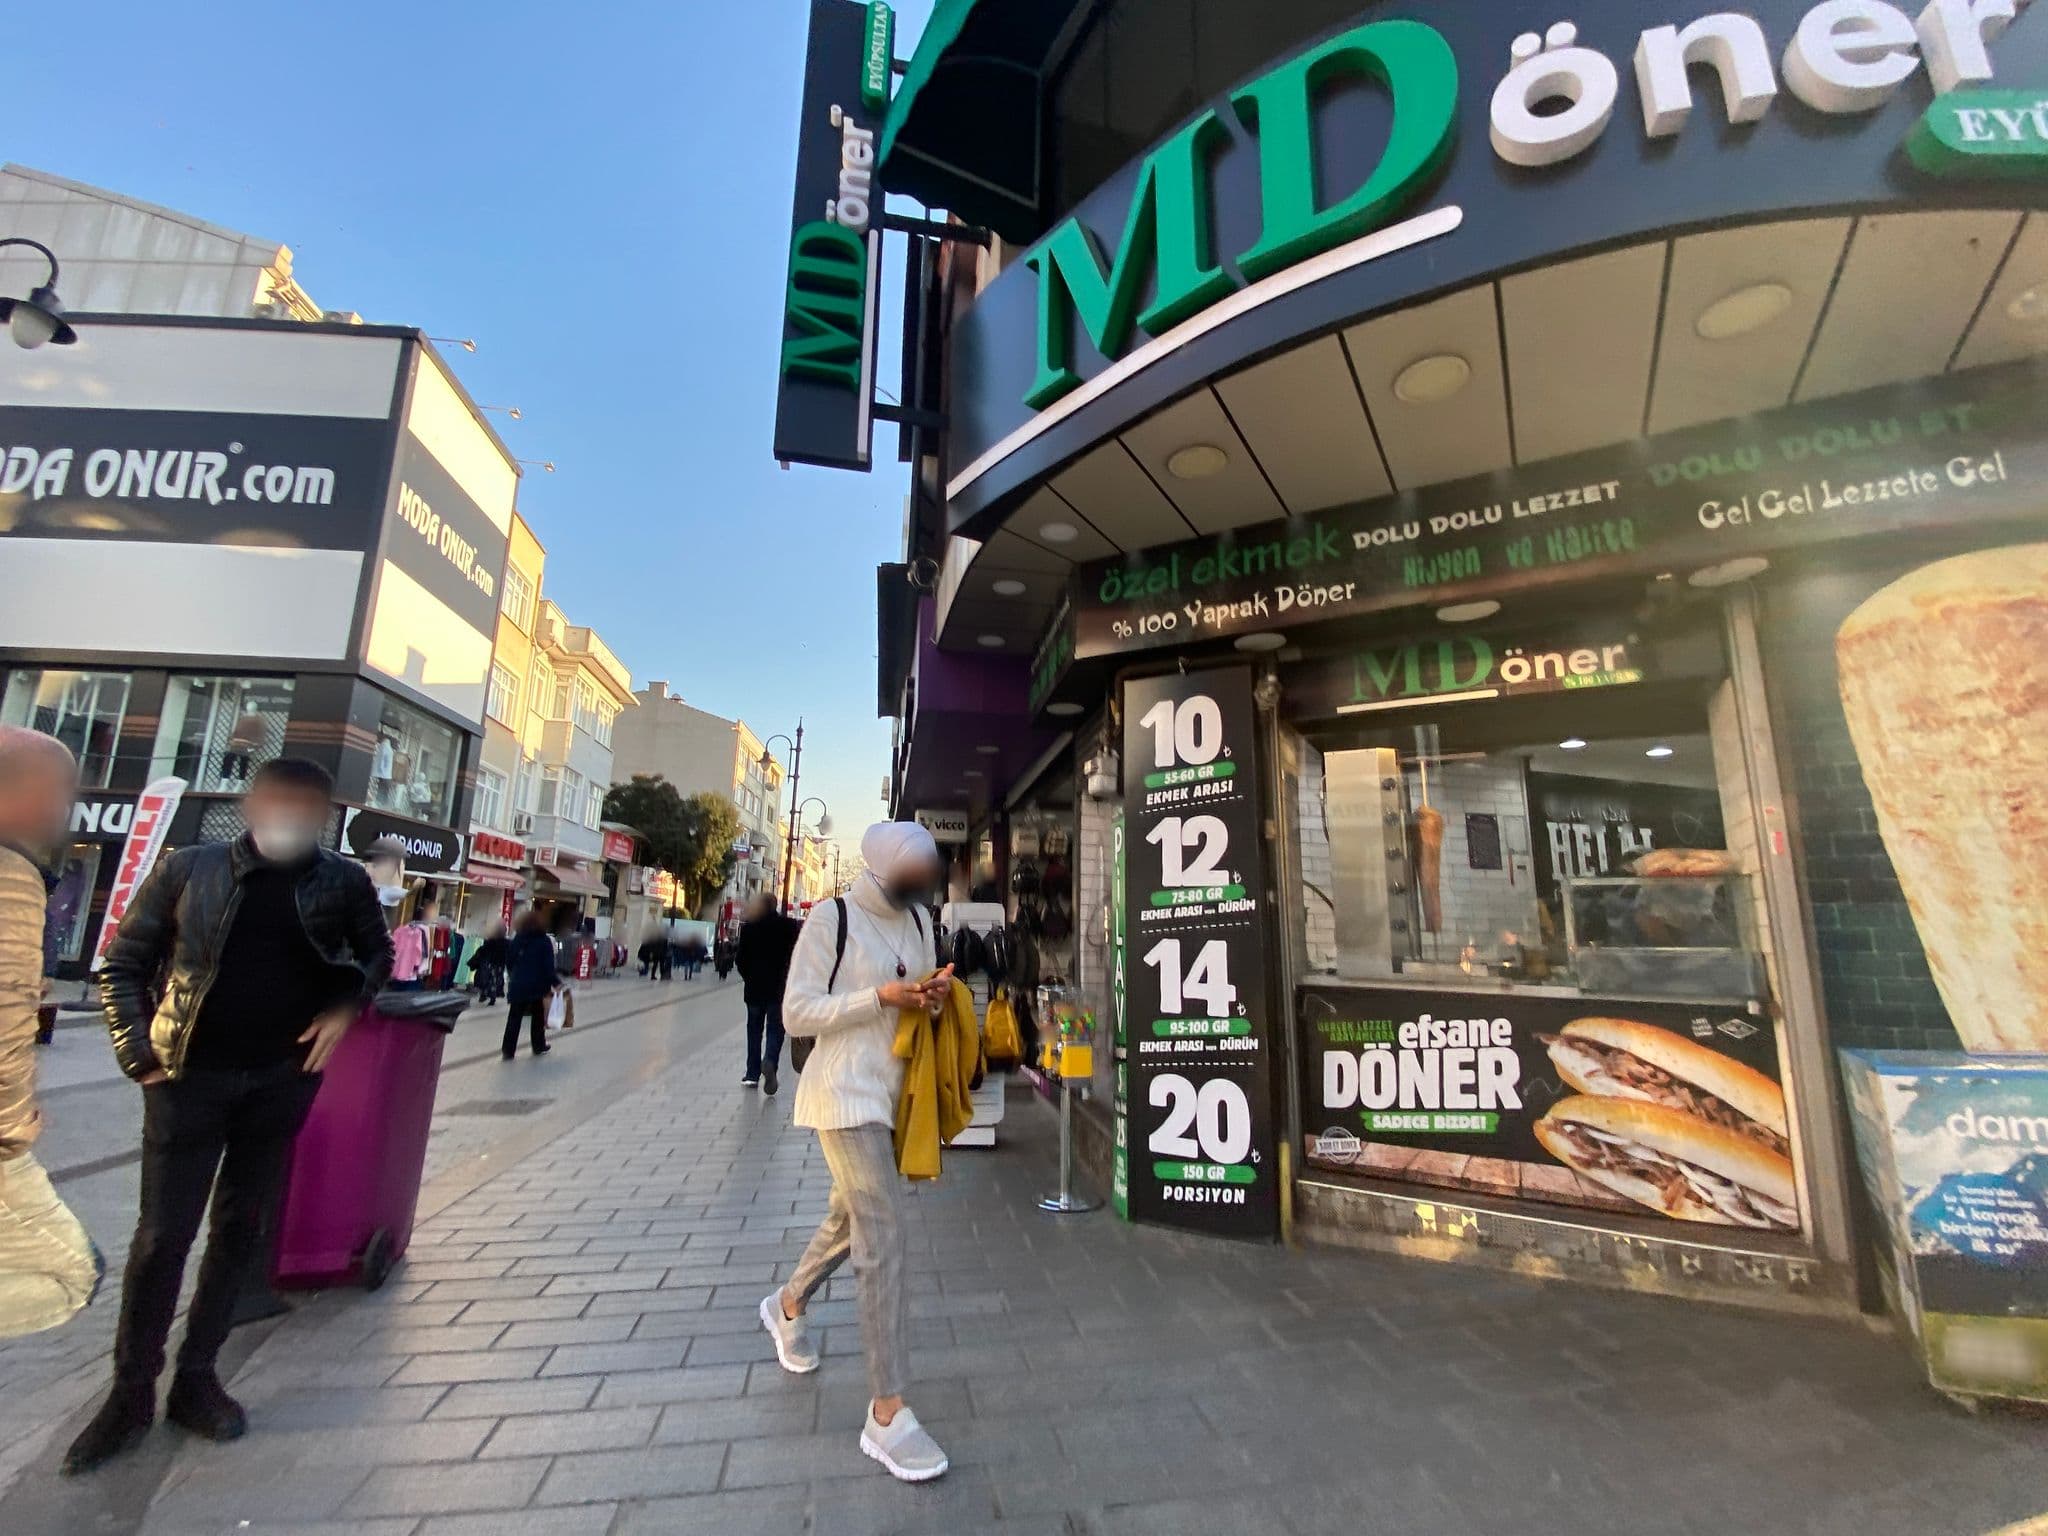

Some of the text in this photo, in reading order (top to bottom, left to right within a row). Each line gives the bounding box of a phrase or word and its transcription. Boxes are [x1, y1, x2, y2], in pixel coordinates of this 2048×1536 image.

[1023, 0, 2014, 410] MD öner
[784, 117, 874, 393] MD öner
[0, 446, 73, 501] DA
[1697, 451, 2007, 528] Gel Gel Lezzete Gel
[397, 482, 438, 546] MODA
[1353, 481, 1620, 550] DOLU DOLU LEZZET
[1100, 524, 1341, 604] özel ekmek
[1184, 592, 1268, 630] Yaprak
[1275, 580, 1356, 612] Döner
[1354, 635, 1624, 700] MD öner
[1140, 695, 1222, 767] 10
[1146, 779, 1233, 805] EKMEK ARASI
[1164, 765, 1215, 785] 55-60 GR
[935, 818, 965, 831] vicco
[1146, 814, 1229, 888] 12
[1141, 908, 1172, 921] EKMEK
[1174, 904, 1203, 919] ARASI
[1218, 898, 1256, 914] DÜRÜM
[1206, 887, 1223, 900] GR
[1143, 938, 1236, 1017] 14
[1139, 1040, 1172, 1052] EKMEK
[1174, 1039, 1204, 1052] ARASI
[1219, 1037, 1259, 1051] DÜRÜM
[1170, 1020, 1230, 1034] 95-100 GR
[1398, 1014, 1513, 1049] efsane
[1323, 1042, 1523, 1110] DÖNER
[1148, 1073, 1251, 1164] 20
[1372, 1114, 1429, 1129] SADECE
[1183, 1165, 1225, 1180] 150 GR
